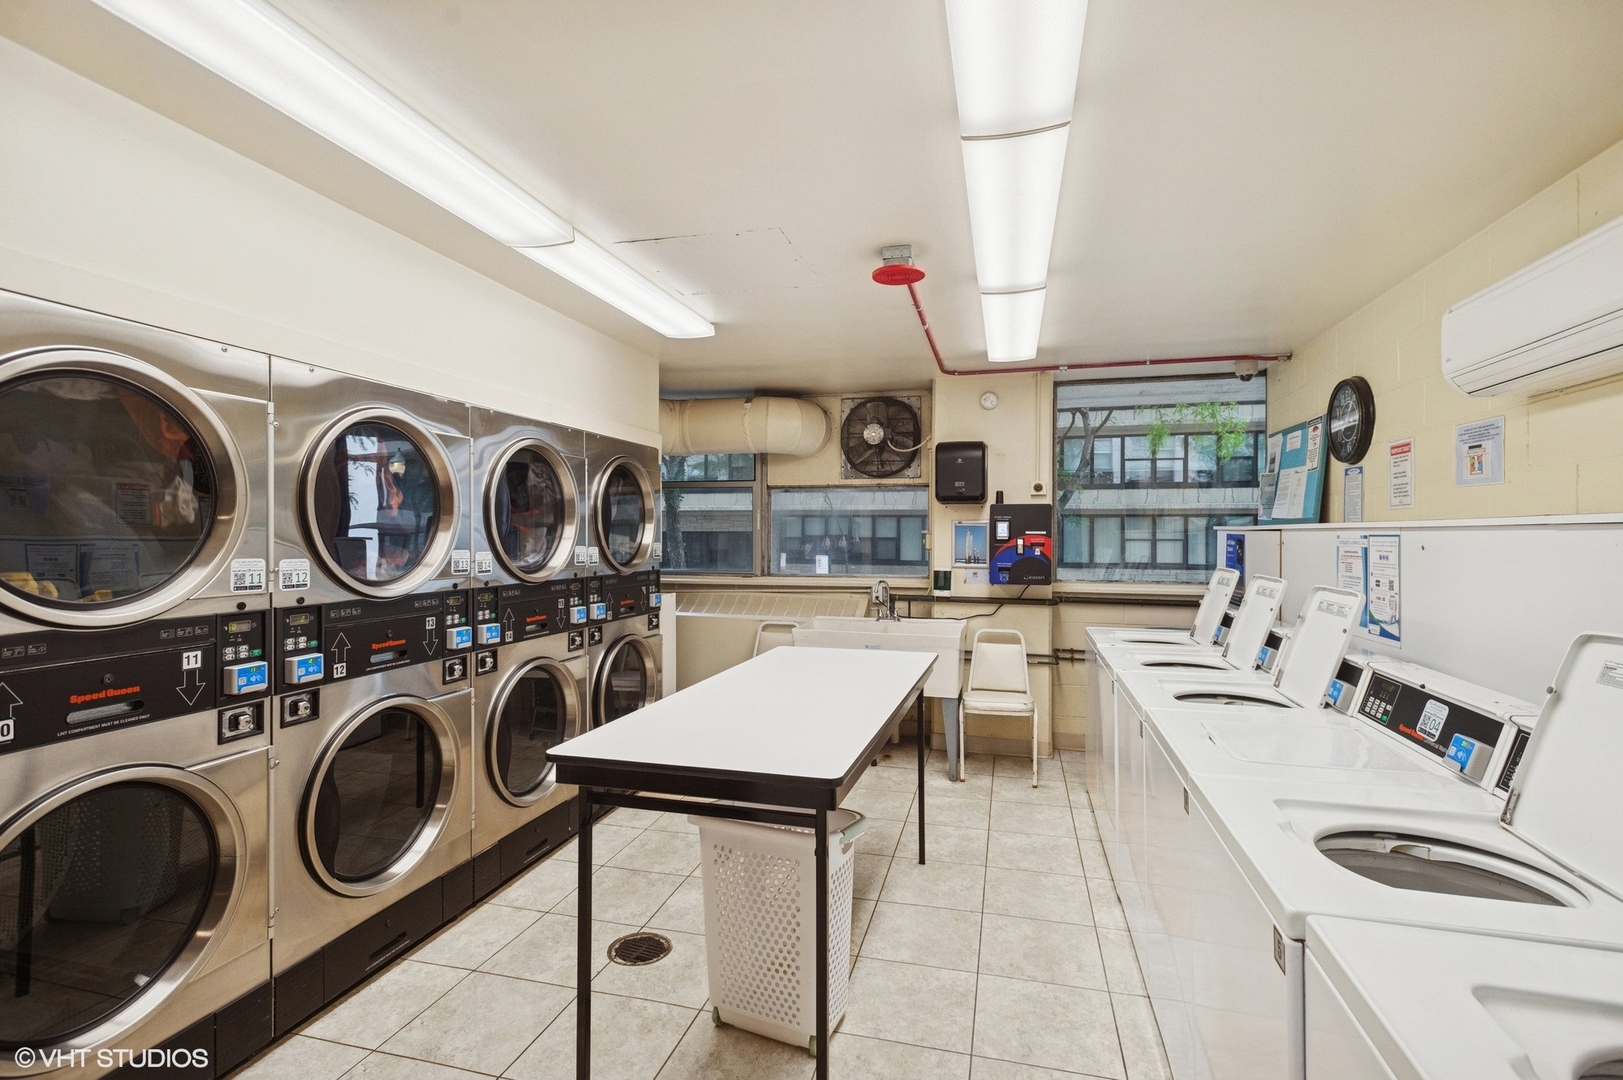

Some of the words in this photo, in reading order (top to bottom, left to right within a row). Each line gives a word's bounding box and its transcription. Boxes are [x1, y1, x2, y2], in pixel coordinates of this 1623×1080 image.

[1391, 445, 1411, 454] IMPORTANT
[461, 560, 469, 568] 13
[249, 573, 263, 584] 11
[295, 572, 308, 583] 12
[427, 618, 435, 628] 13
[185, 654, 198, 666] 11
[334, 665, 345, 676] 12
[69, 691, 106, 704] Speed
[106, 685, 141, 697] Queen
[0, 723, 11, 738] 0
[68, 724, 101, 734] COMPARTMENT
[120, 716, 139, 724] CLEANED
[1428, 719, 1441, 733] 04
